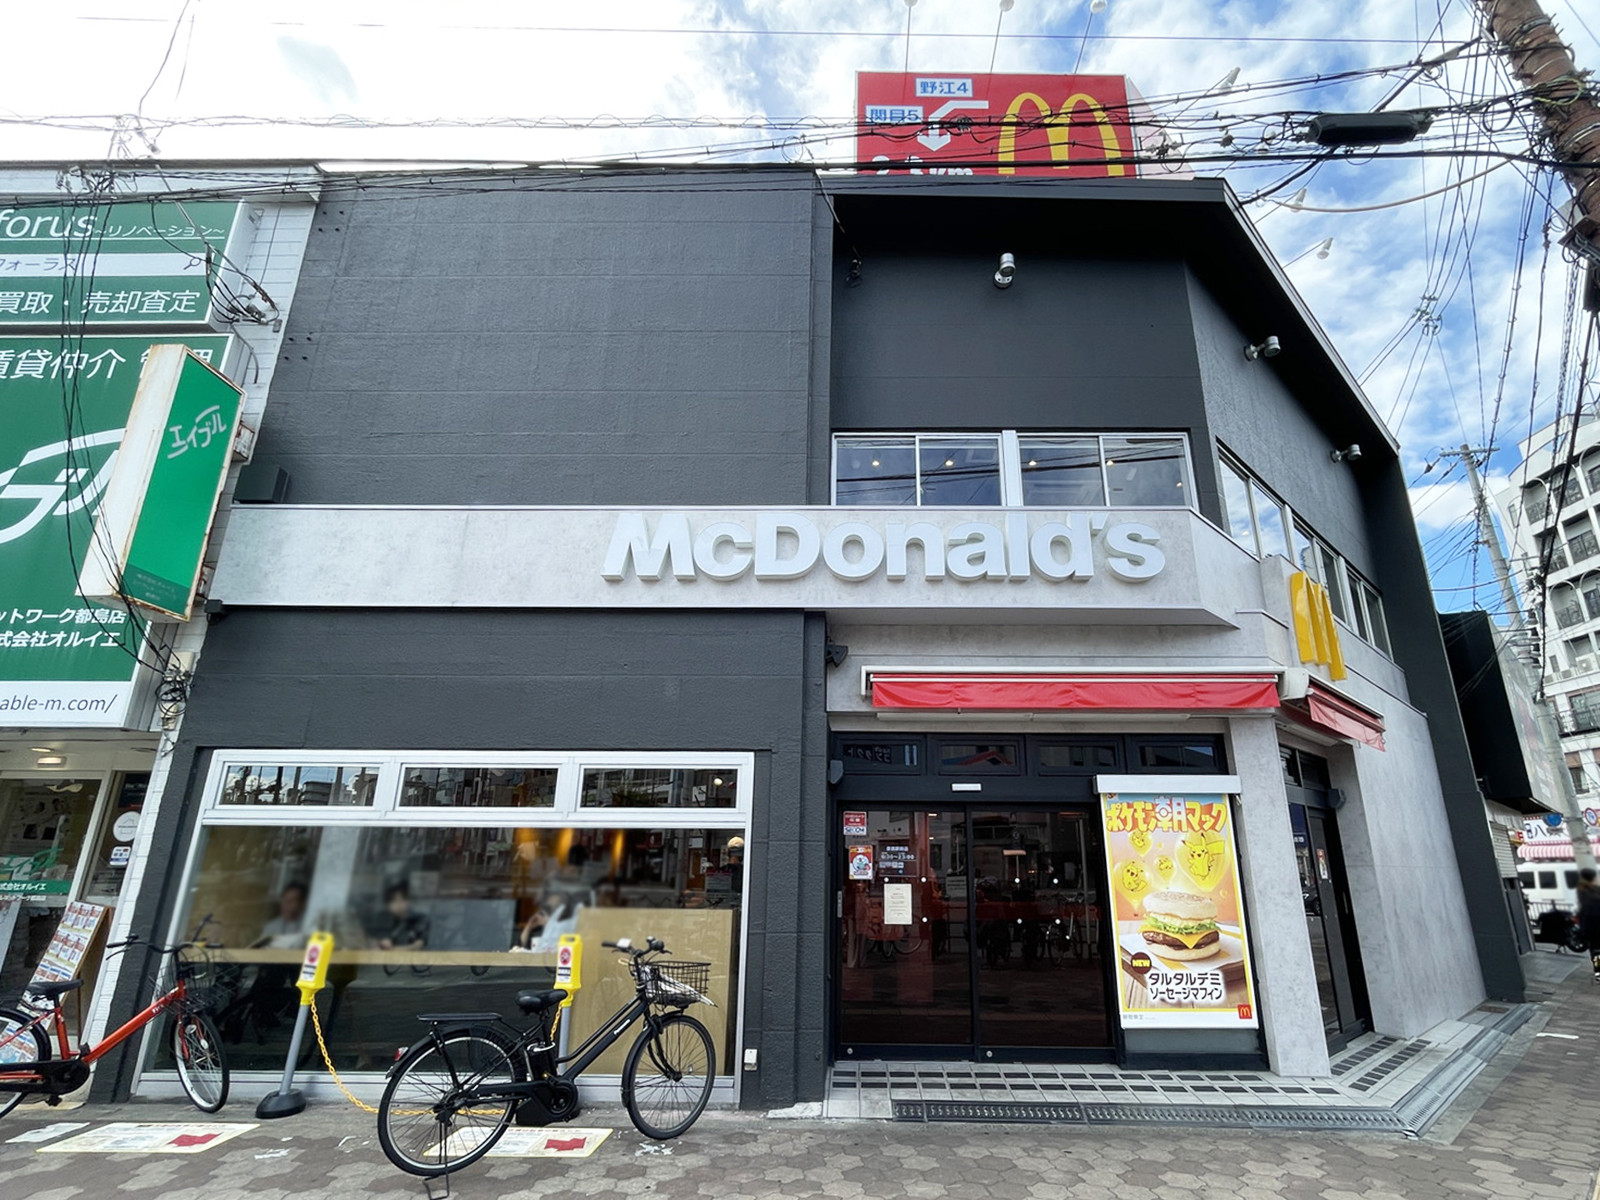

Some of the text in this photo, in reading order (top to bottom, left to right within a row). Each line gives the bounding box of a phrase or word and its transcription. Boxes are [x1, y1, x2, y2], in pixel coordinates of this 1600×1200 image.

[920, 81, 968, 94] 野江4
[0, 209, 97, 237] forus
[169, 410, 227, 450] エイブル
[603, 511, 1166, 584] McDonald's
[0, 694, 118, 714] able-m.com/
[1132, 959, 1151, 967] NEW
[1149, 972, 1222, 986] タルタルデミ
[1150, 986, 1223, 1000] ソーセージマフィン
